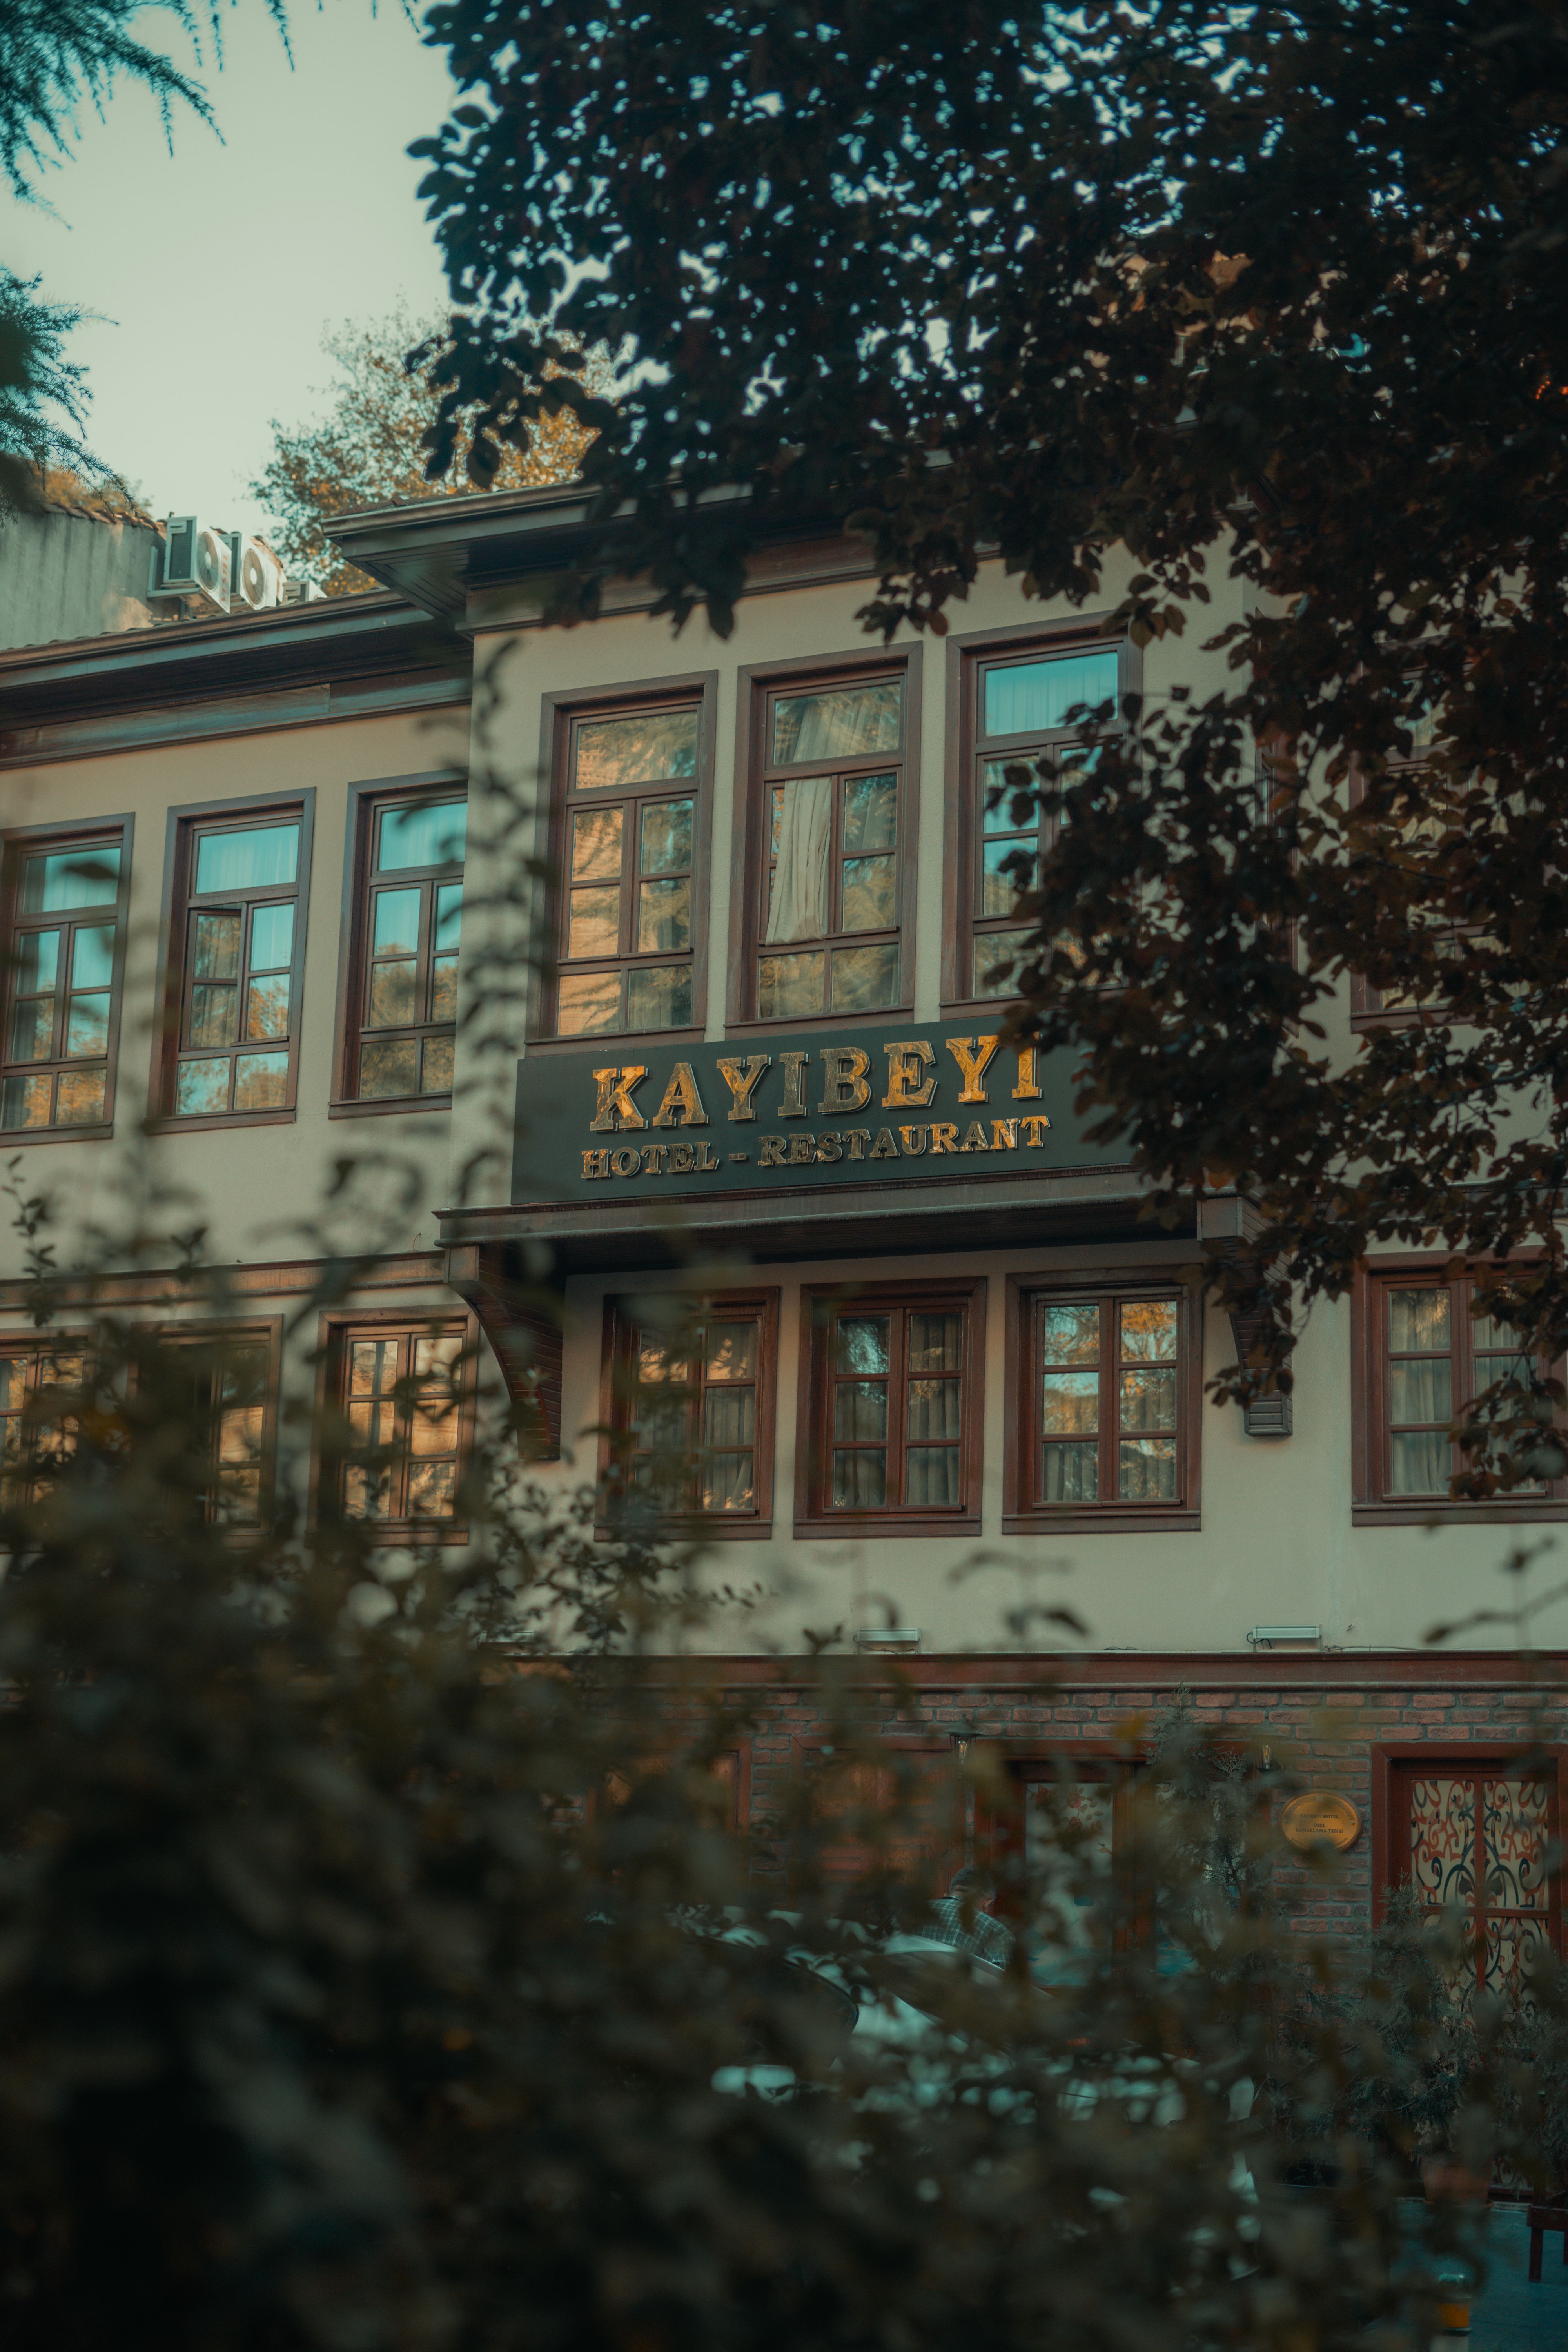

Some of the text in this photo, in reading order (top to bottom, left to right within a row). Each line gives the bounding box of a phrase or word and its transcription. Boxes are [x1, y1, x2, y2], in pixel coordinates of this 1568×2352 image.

[580, 1115, 1052, 1180] HOTEL - RESTAURANT
